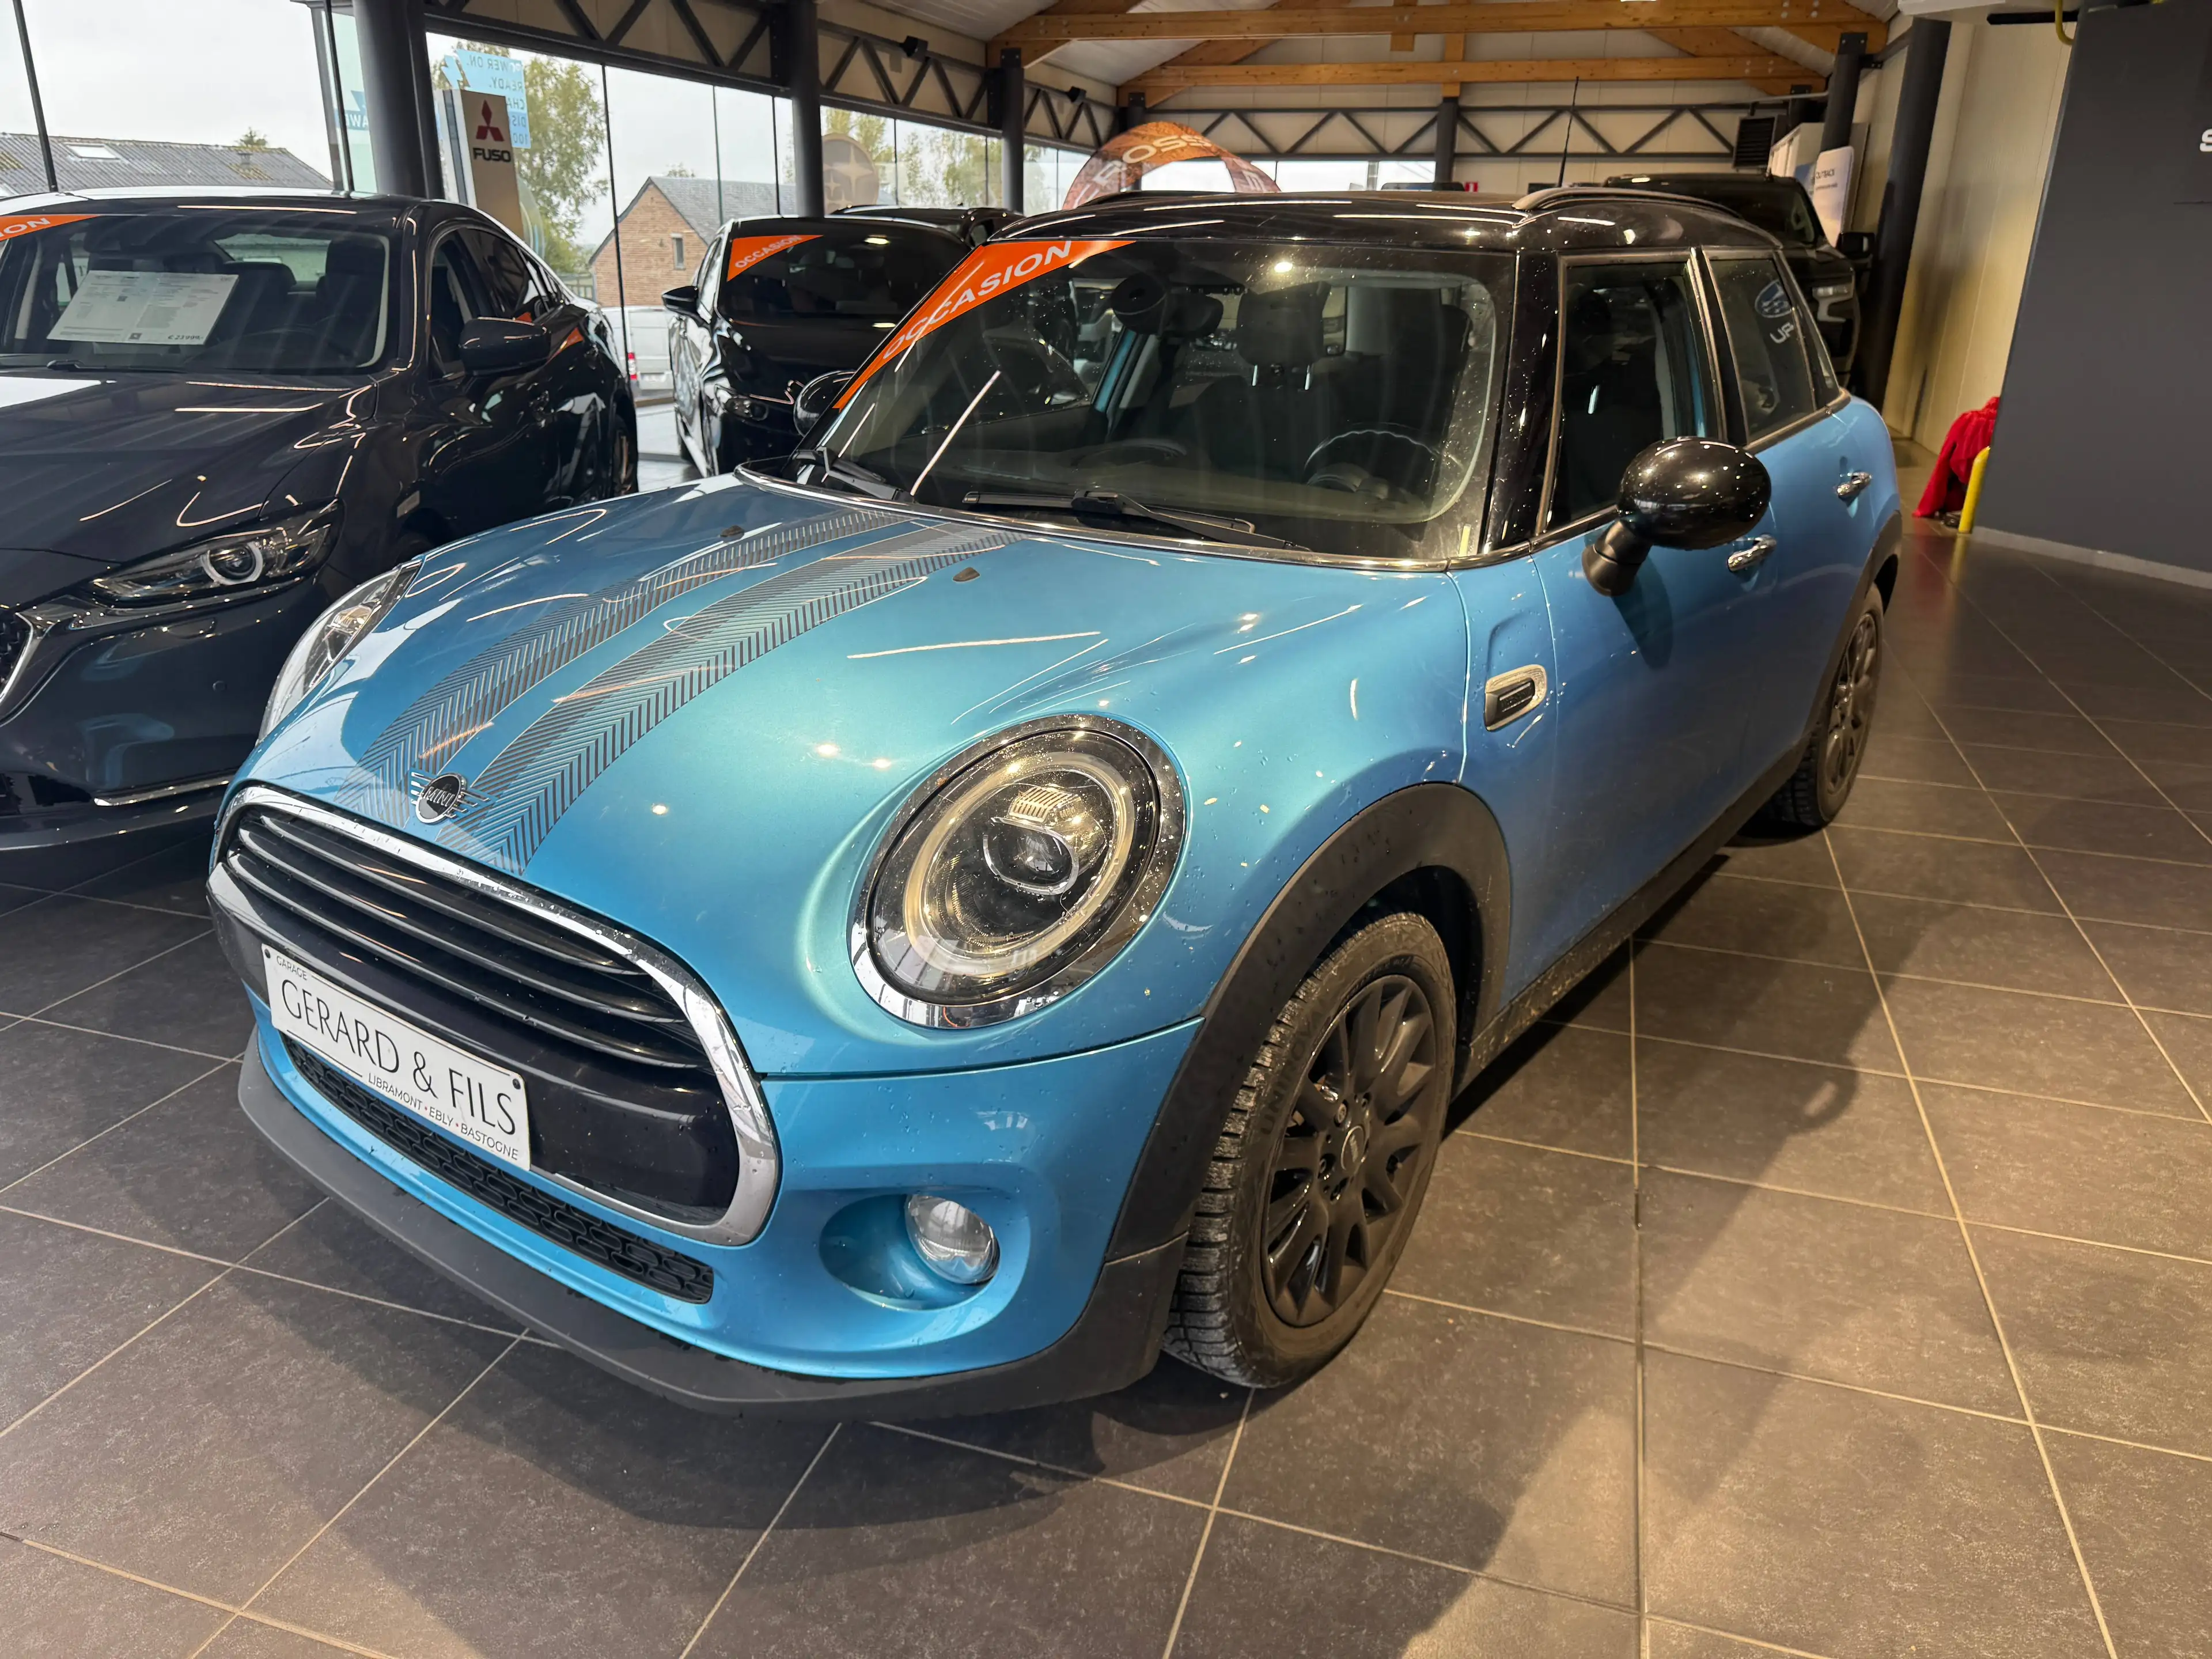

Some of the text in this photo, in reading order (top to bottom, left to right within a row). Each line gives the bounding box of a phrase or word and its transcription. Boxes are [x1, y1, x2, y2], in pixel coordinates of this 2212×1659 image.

[472, 147, 511, 162] FUSO
[734, 235, 802, 268] OCCASION
[882, 240, 1071, 359] OCCASION
[423, 786, 455, 807] MINI
[276, 955, 308, 980] GARAGE
[281, 979, 516, 1135] GERARD & FILS
[368, 1073, 518, 1161] LIBRAMONT EBLY BASTOGNE
